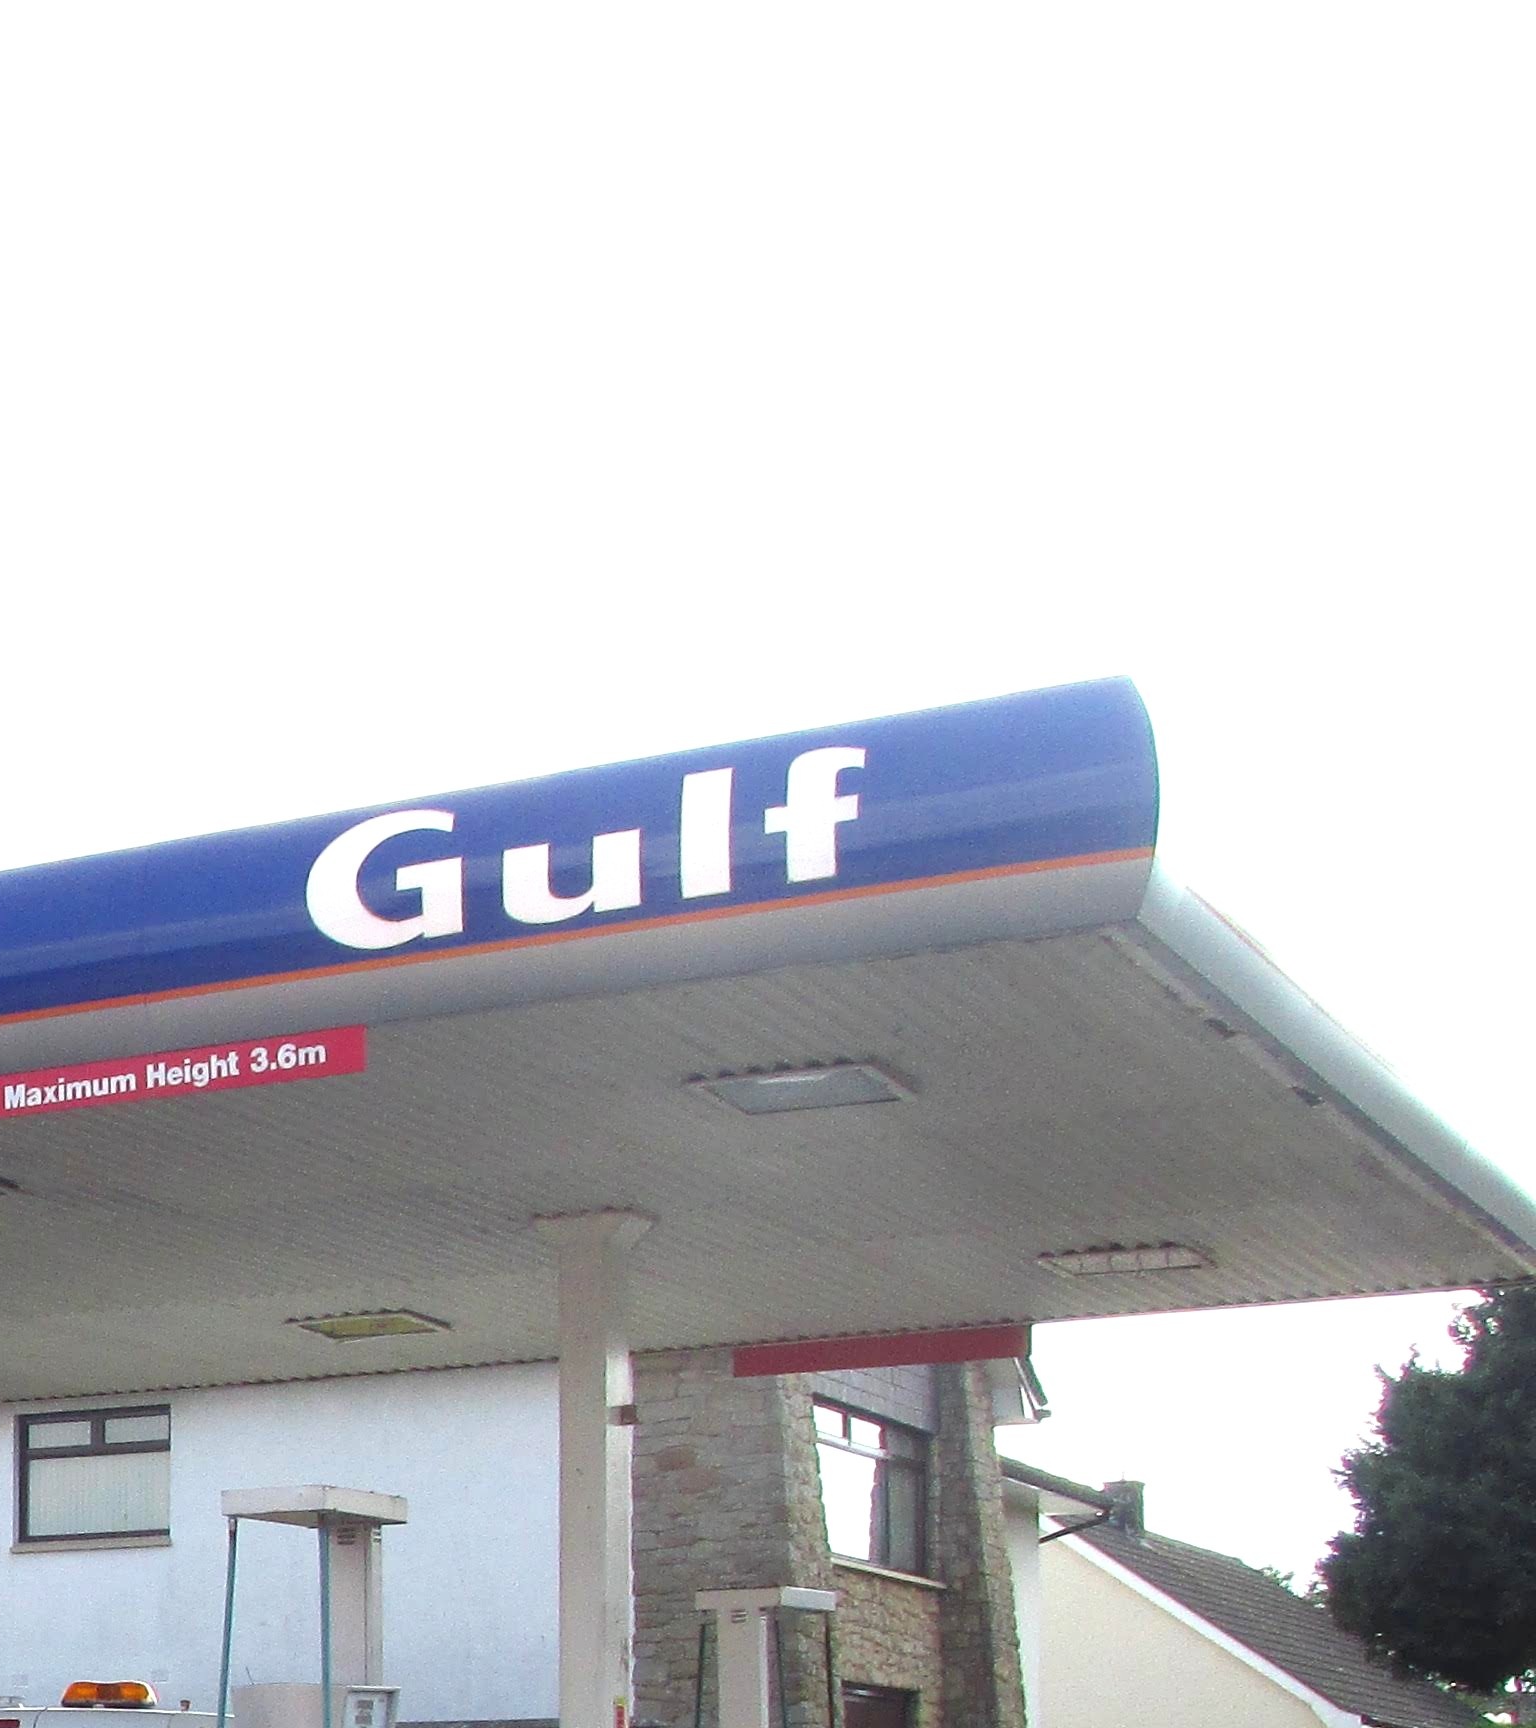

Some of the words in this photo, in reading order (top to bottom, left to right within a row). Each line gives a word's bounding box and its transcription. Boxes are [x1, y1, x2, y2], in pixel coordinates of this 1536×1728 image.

[305, 745, 867, 950] Gulf
[2, 1071, 137, 1110] Maximum
[145, 1053, 241, 1088] Height
[249, 1042, 327, 1073] 3.6m
